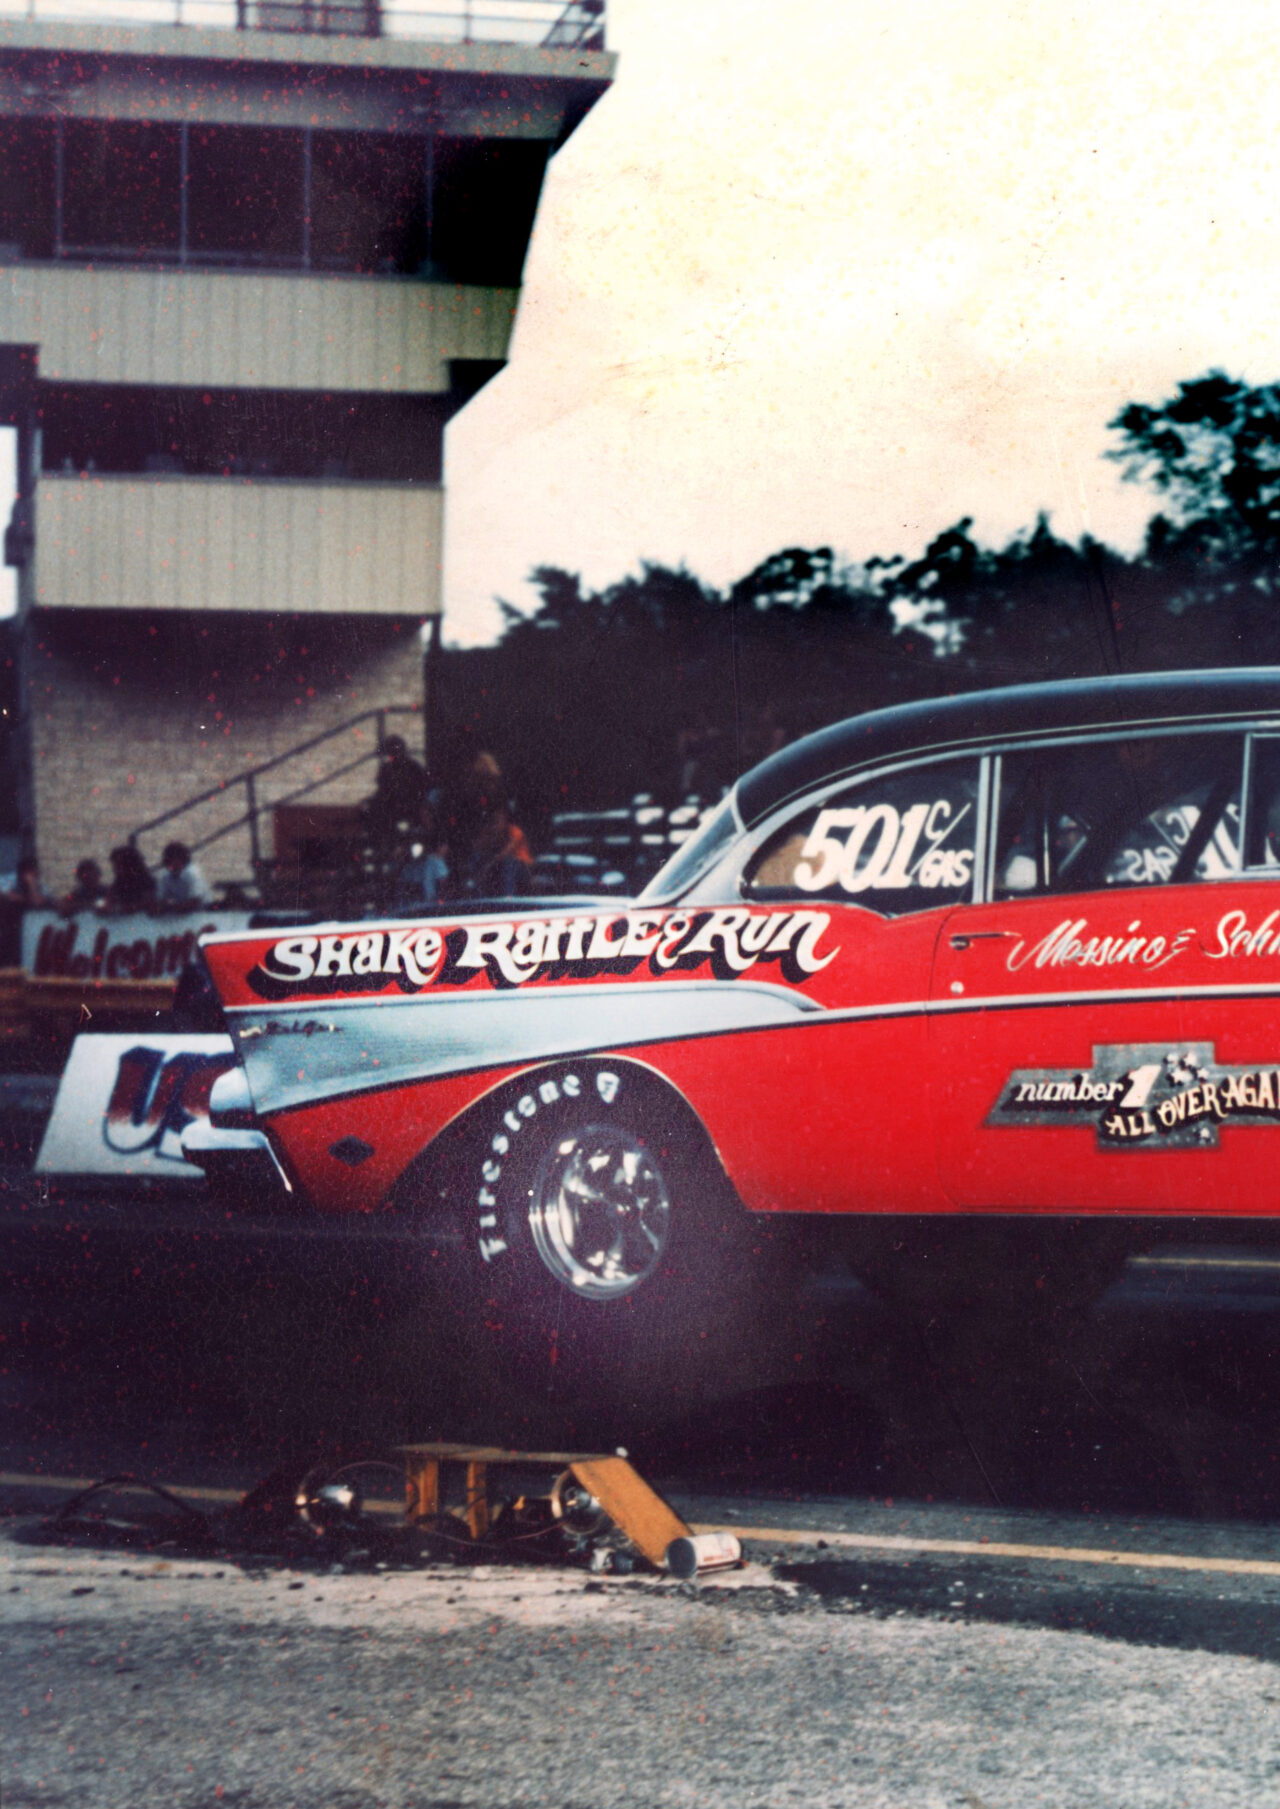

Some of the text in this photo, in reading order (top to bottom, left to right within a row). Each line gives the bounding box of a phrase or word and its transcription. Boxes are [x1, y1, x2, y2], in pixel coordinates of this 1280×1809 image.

[794, 804, 930, 893] 501
[34, 921, 217, 979] Welcom
[1015, 1064, 1162, 1109] number 1
[1105, 1113, 1157, 1137] ALL
[1158, 1083, 1229, 1127] OVER
